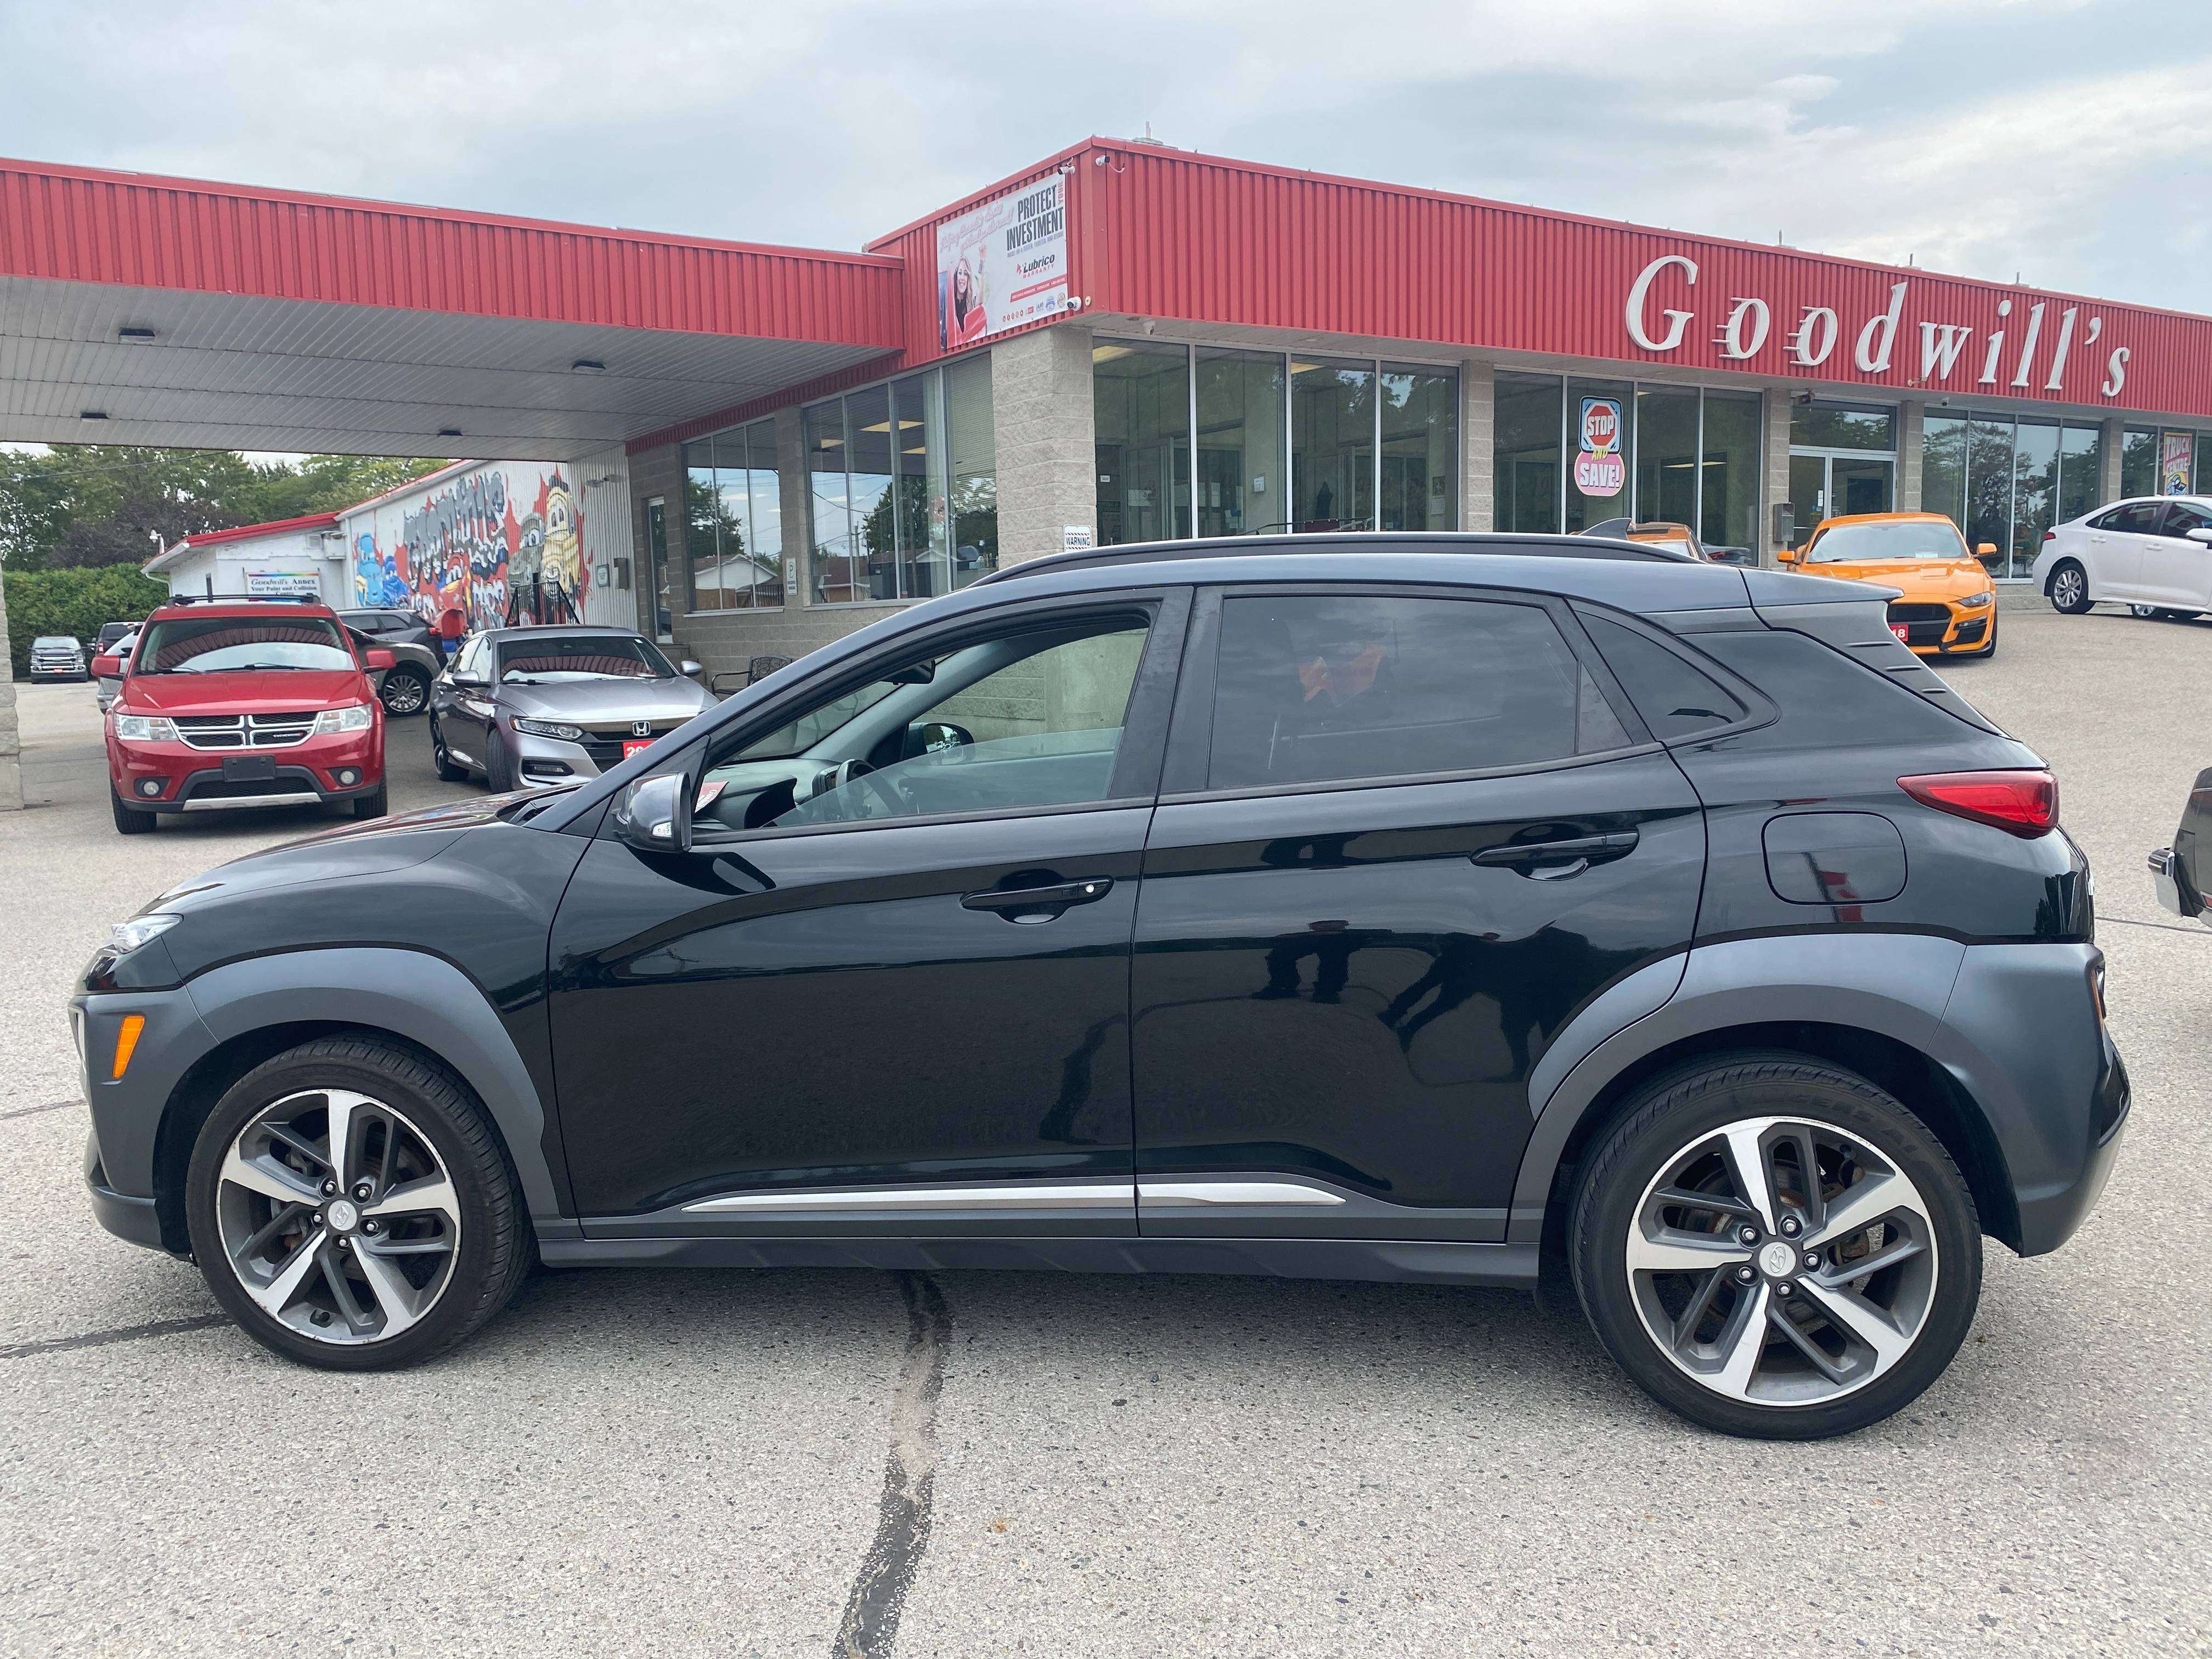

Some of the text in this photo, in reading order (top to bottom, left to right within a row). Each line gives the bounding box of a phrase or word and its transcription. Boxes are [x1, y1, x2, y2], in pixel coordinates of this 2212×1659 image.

[1018, 184, 1057, 222] PROTECT
[1007, 206, 1064, 251] INVESTMENT
[1023, 254, 1055, 274] Lubrico
[1023, 263, 1054, 279] WARRANTY
[1626, 255, 2130, 397] Goodwill's
[1587, 415, 1615, 437] STOP
[1592, 447, 1609, 461] AND
[2166, 436, 2191, 461] TRUCK
[1579, 462, 1620, 488] SAVE!
[2167, 456, 2188, 476] CENTRE
[1066, 537, 1090, 546] WARNING
